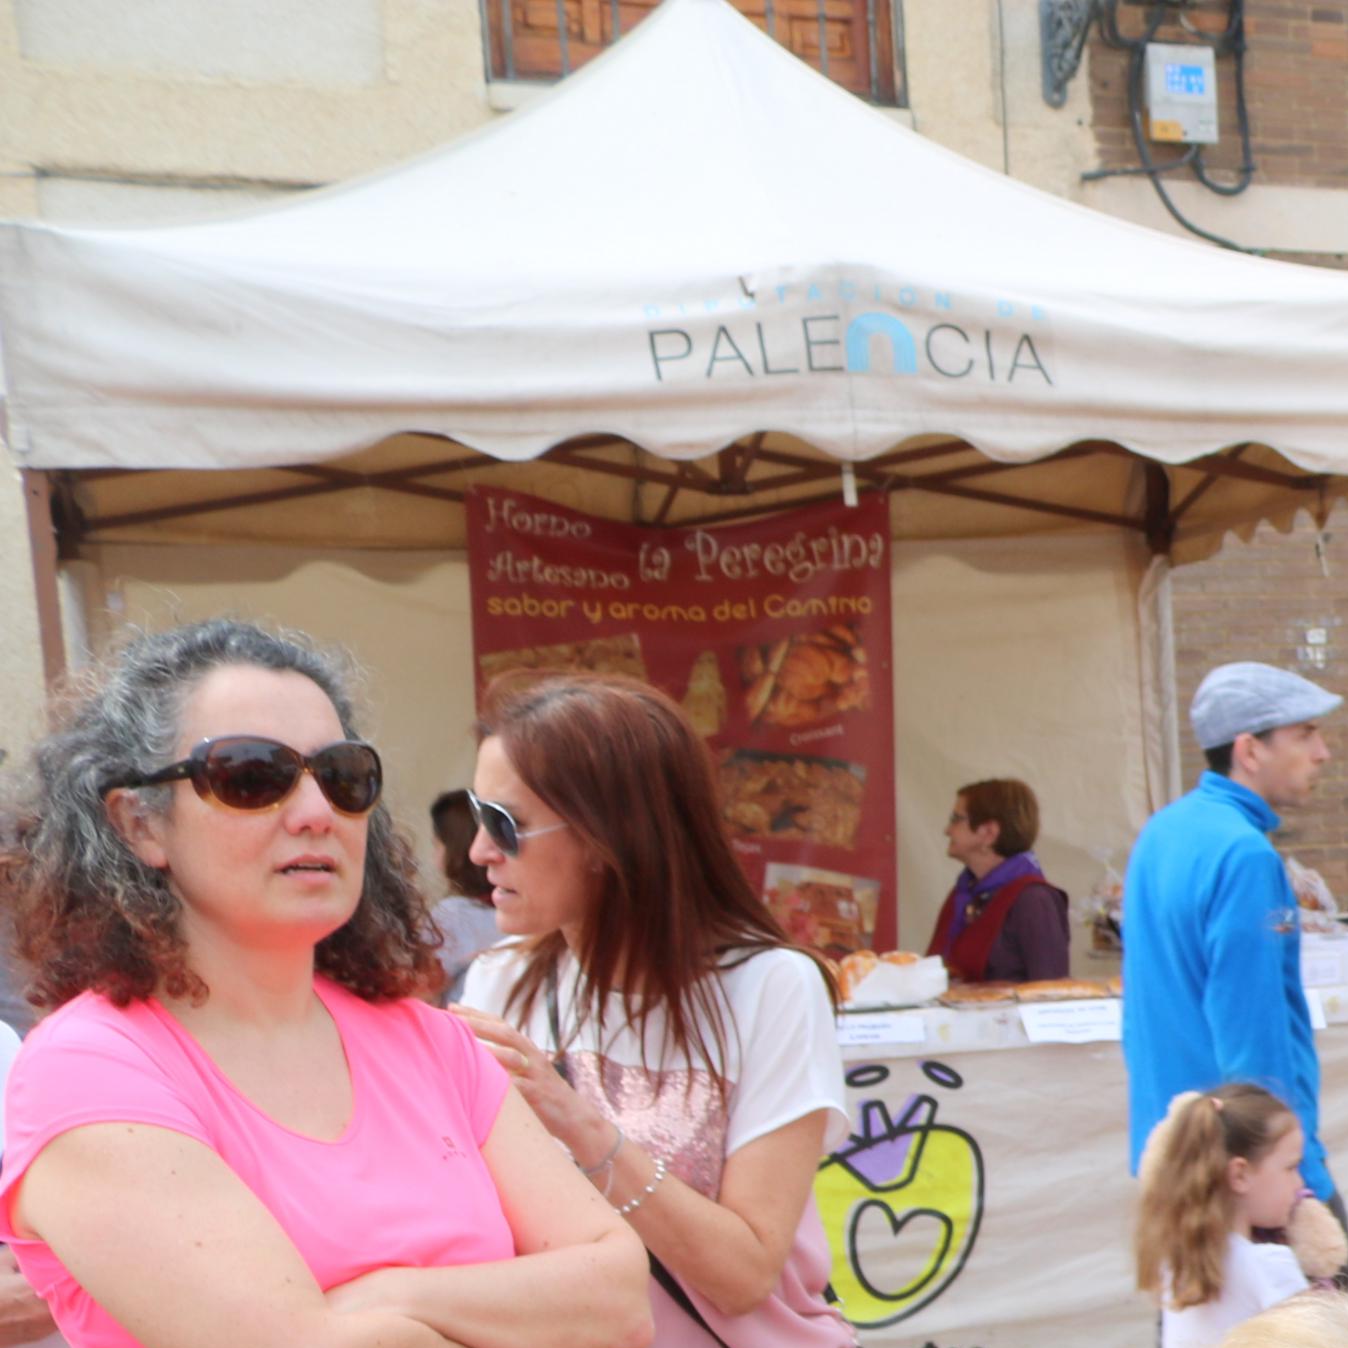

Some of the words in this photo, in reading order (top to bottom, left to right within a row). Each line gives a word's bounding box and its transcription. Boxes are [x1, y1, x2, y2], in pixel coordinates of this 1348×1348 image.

[485, 497, 593, 540] Horno
[487, 552, 630, 590] Artesano
[684, 527, 884, 583] Peregrina
[487, 594, 574, 617] sabor
[582, 601, 601, 624] y
[608, 602, 706, 622] aroma
[713, 598, 756, 621] del
[764, 594, 873, 616] Camino
